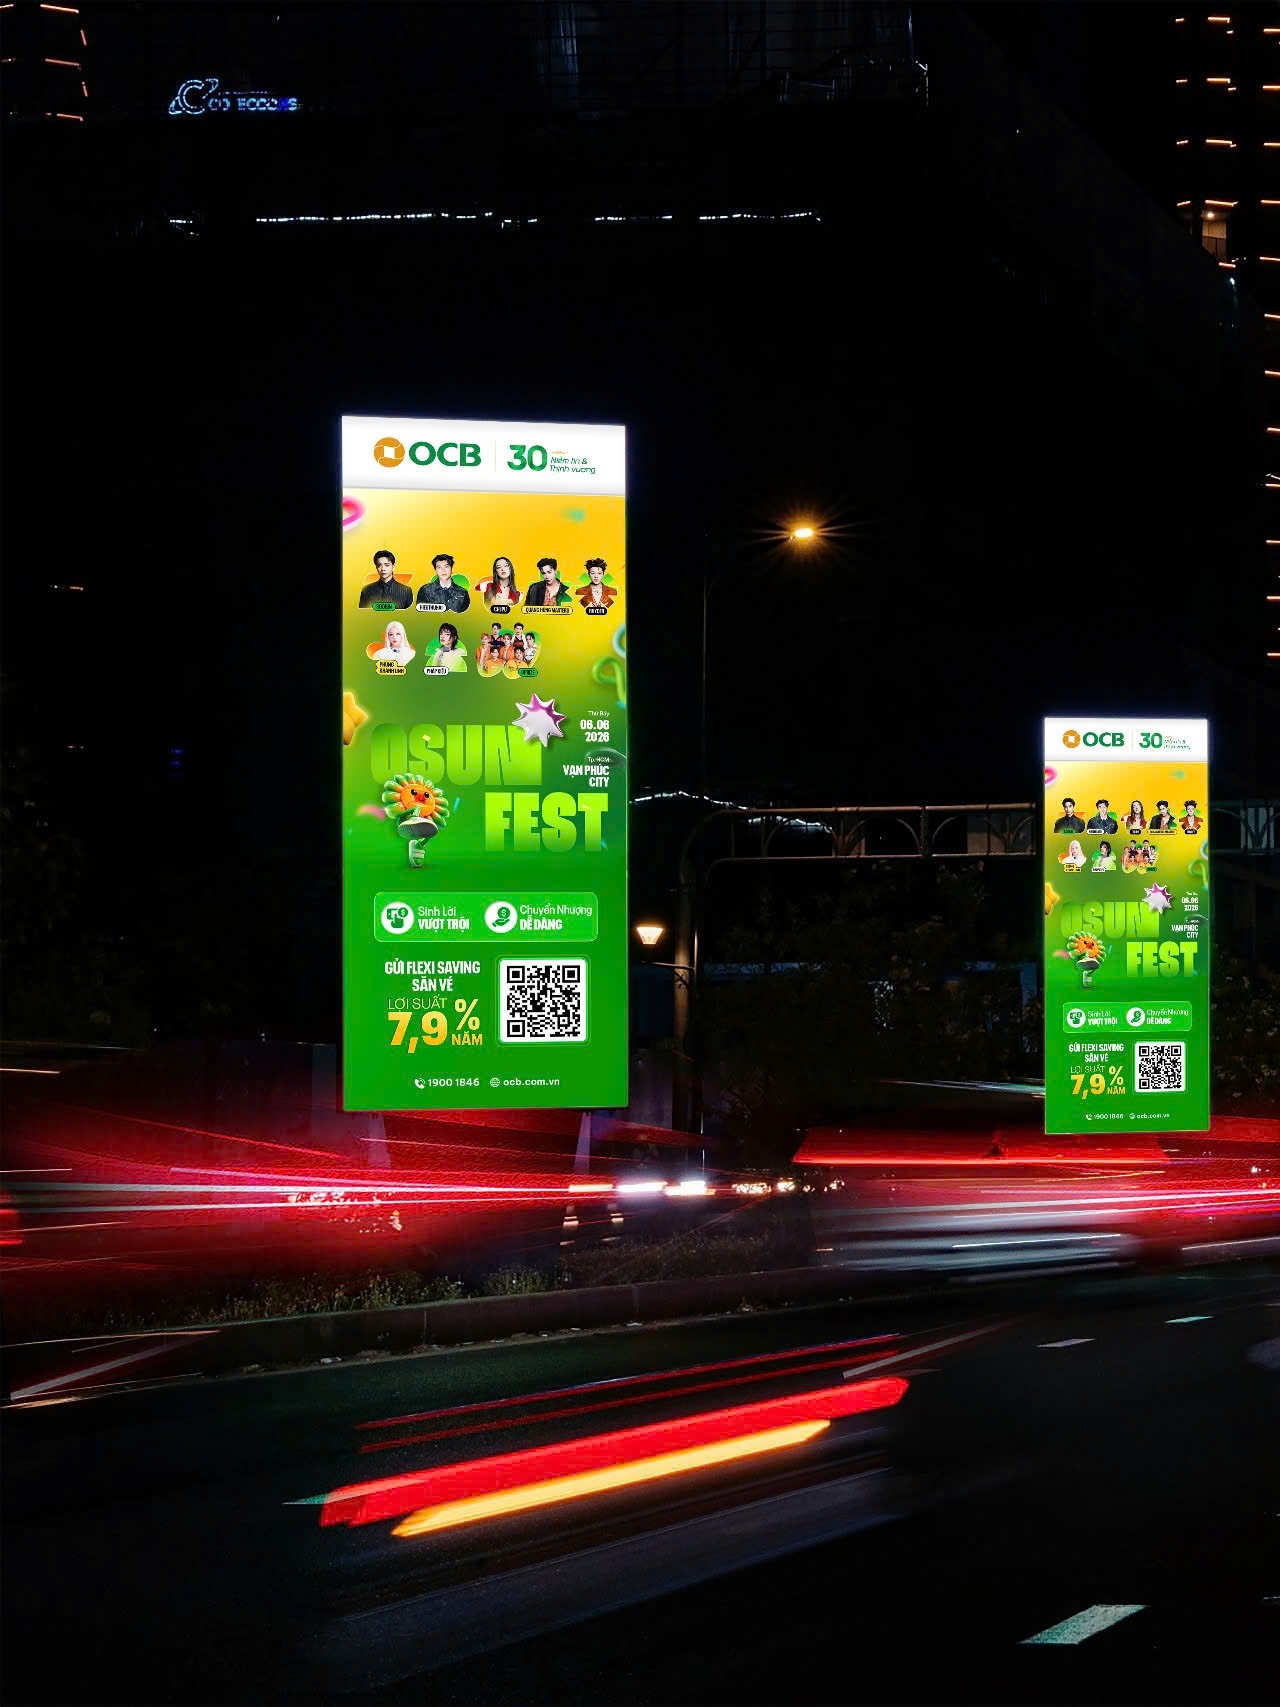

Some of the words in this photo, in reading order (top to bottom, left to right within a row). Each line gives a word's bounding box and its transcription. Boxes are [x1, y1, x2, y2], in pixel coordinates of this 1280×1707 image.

[408, 441, 482, 467] OCB
[507, 444, 548, 471] 30
[580, 720, 610, 730] 06.06
[585, 732, 610, 742] 2026
[1083, 731, 1125, 747] OCB
[1139, 732, 1163, 748] 30
[370, 723, 542, 786] OSUN
[563, 765, 583, 778] VẠN
[584, 764, 610, 775] PHÚC
[588, 777, 610, 787] CITY
[485, 792, 608, 852] FEST
[418, 906, 440, 916] Sinh
[442, 905, 456, 916] Lời
[520, 904, 555, 916] Chuyển
[556, 905, 592, 917] Nhượng
[418, 918, 445, 933] VƯỢT
[446, 916, 470, 933] TRỘI
[534, 916, 562, 930] DÀNG
[1061, 901, 1160, 939] OSUN
[384, 958, 406, 974] GỬI
[407, 961, 435, 974] FLEXI
[437, 961, 480, 974] SAVING
[1127, 942, 1198, 978] FEST
[412, 976, 437, 991] SĂN
[439, 976, 453, 991] VÉ
[388, 998, 409, 1012] LỢI
[412, 994, 447, 1010] SUẤT
[387, 1011, 448, 1053] 7,9
[454, 998, 480, 1030] %
[452, 1030, 482, 1045] NĂM
[1082, 1044, 1098, 1052] FLEXI
[428, 1078, 452, 1086] 1900
[455, 1078, 480, 1086] 1846
[503, 1078, 560, 1086] ocb.com.vn
[1071, 1074, 1105, 1099] 7,9
[1109, 1066, 1124, 1085] %
